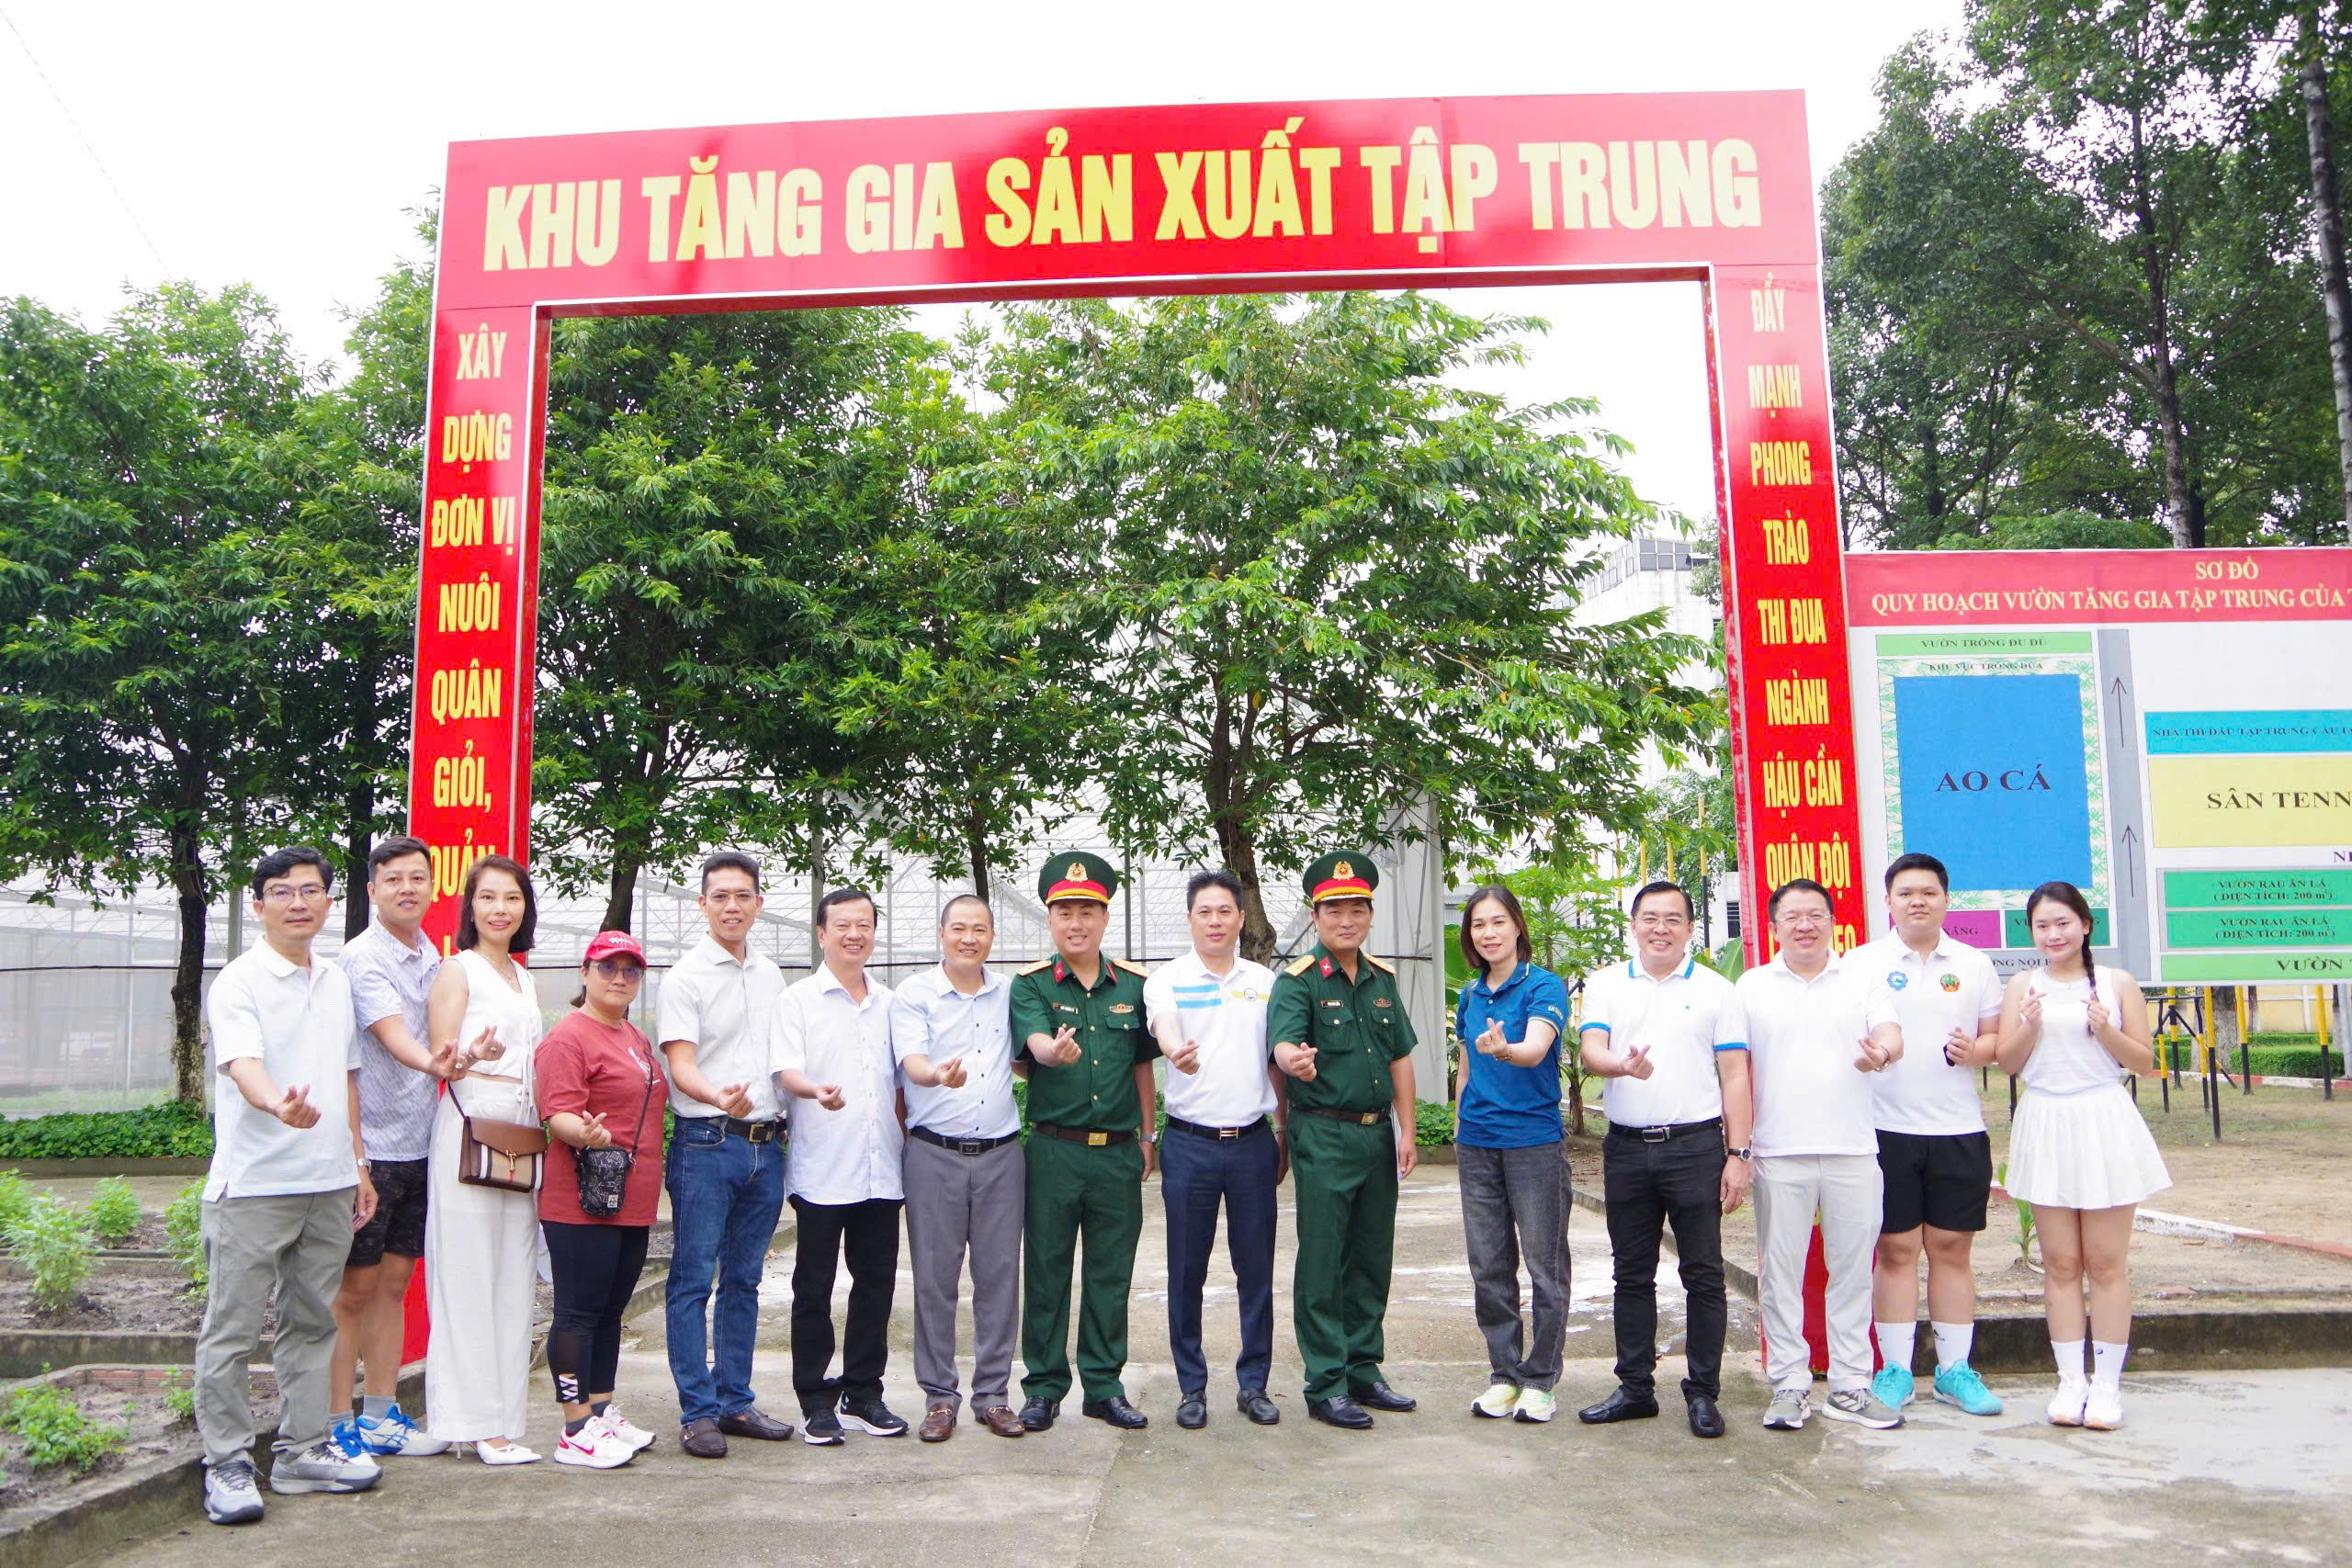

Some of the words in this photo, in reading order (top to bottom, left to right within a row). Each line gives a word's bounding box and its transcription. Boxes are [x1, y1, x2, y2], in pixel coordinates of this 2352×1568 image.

[483, 179, 621, 271] KHU
[641, 155, 822, 263] TĂNG
[845, 162, 964, 254] GIA
[985, 127, 1132, 247] SẢN
[1154, 117, 1340, 241] XUẤT
[1360, 126, 1498, 253] TẬP
[1519, 139, 1761, 230] TRUNG
[1750, 272, 1785, 332] ĐẨY
[456, 323, 506, 380] XÂY
[1748, 365, 1803, 418] MẠNH
[442, 411, 512, 473] DỰNG
[1749, 441, 1812, 486] PHONG
[431, 493, 484, 548] ĐƠN
[492, 497, 515, 556] VỊ
[1762, 510, 1810, 565] TRÀO
[2195, 560, 2223, 580] SƠ
[2228, 556, 2259, 580] ĐỒ
[438, 571, 501, 632] NUÔI
[1757, 599, 1785, 645] THI
[1791, 598, 1827, 644] ĐUA
[1871, 593, 1917, 616] QUY
[1922, 592, 1999, 615] HOẠCH
[2004, 587, 2065, 610] VƯỜN
[2069, 587, 2129, 609] TĂNG
[2134, 591, 2173, 608] GIA
[2176, 588, 2219, 613] TẬP
[2221, 589, 2294, 608] TRUNG
[2300, 583, 2345, 607] CỦA
[1921, 637, 1957, 648] VƯỜN
[431, 659, 502, 726] QUÂN
[1765, 669, 1829, 726] NGÀNH
[433, 740, 492, 813] GIỎI,
[1763, 750, 1801, 818] HẬU
[1804, 742, 1843, 807] CẦN
[1935, 771, 1989, 792] AO
[1999, 764, 2052, 791] CÁ
[2207, 787, 2264, 809] SÂN
[1765, 832, 1815, 892] QUÂN
[1818, 831, 1850, 899] ĐỘI
[2276, 956, 2343, 971] VƯỜN
